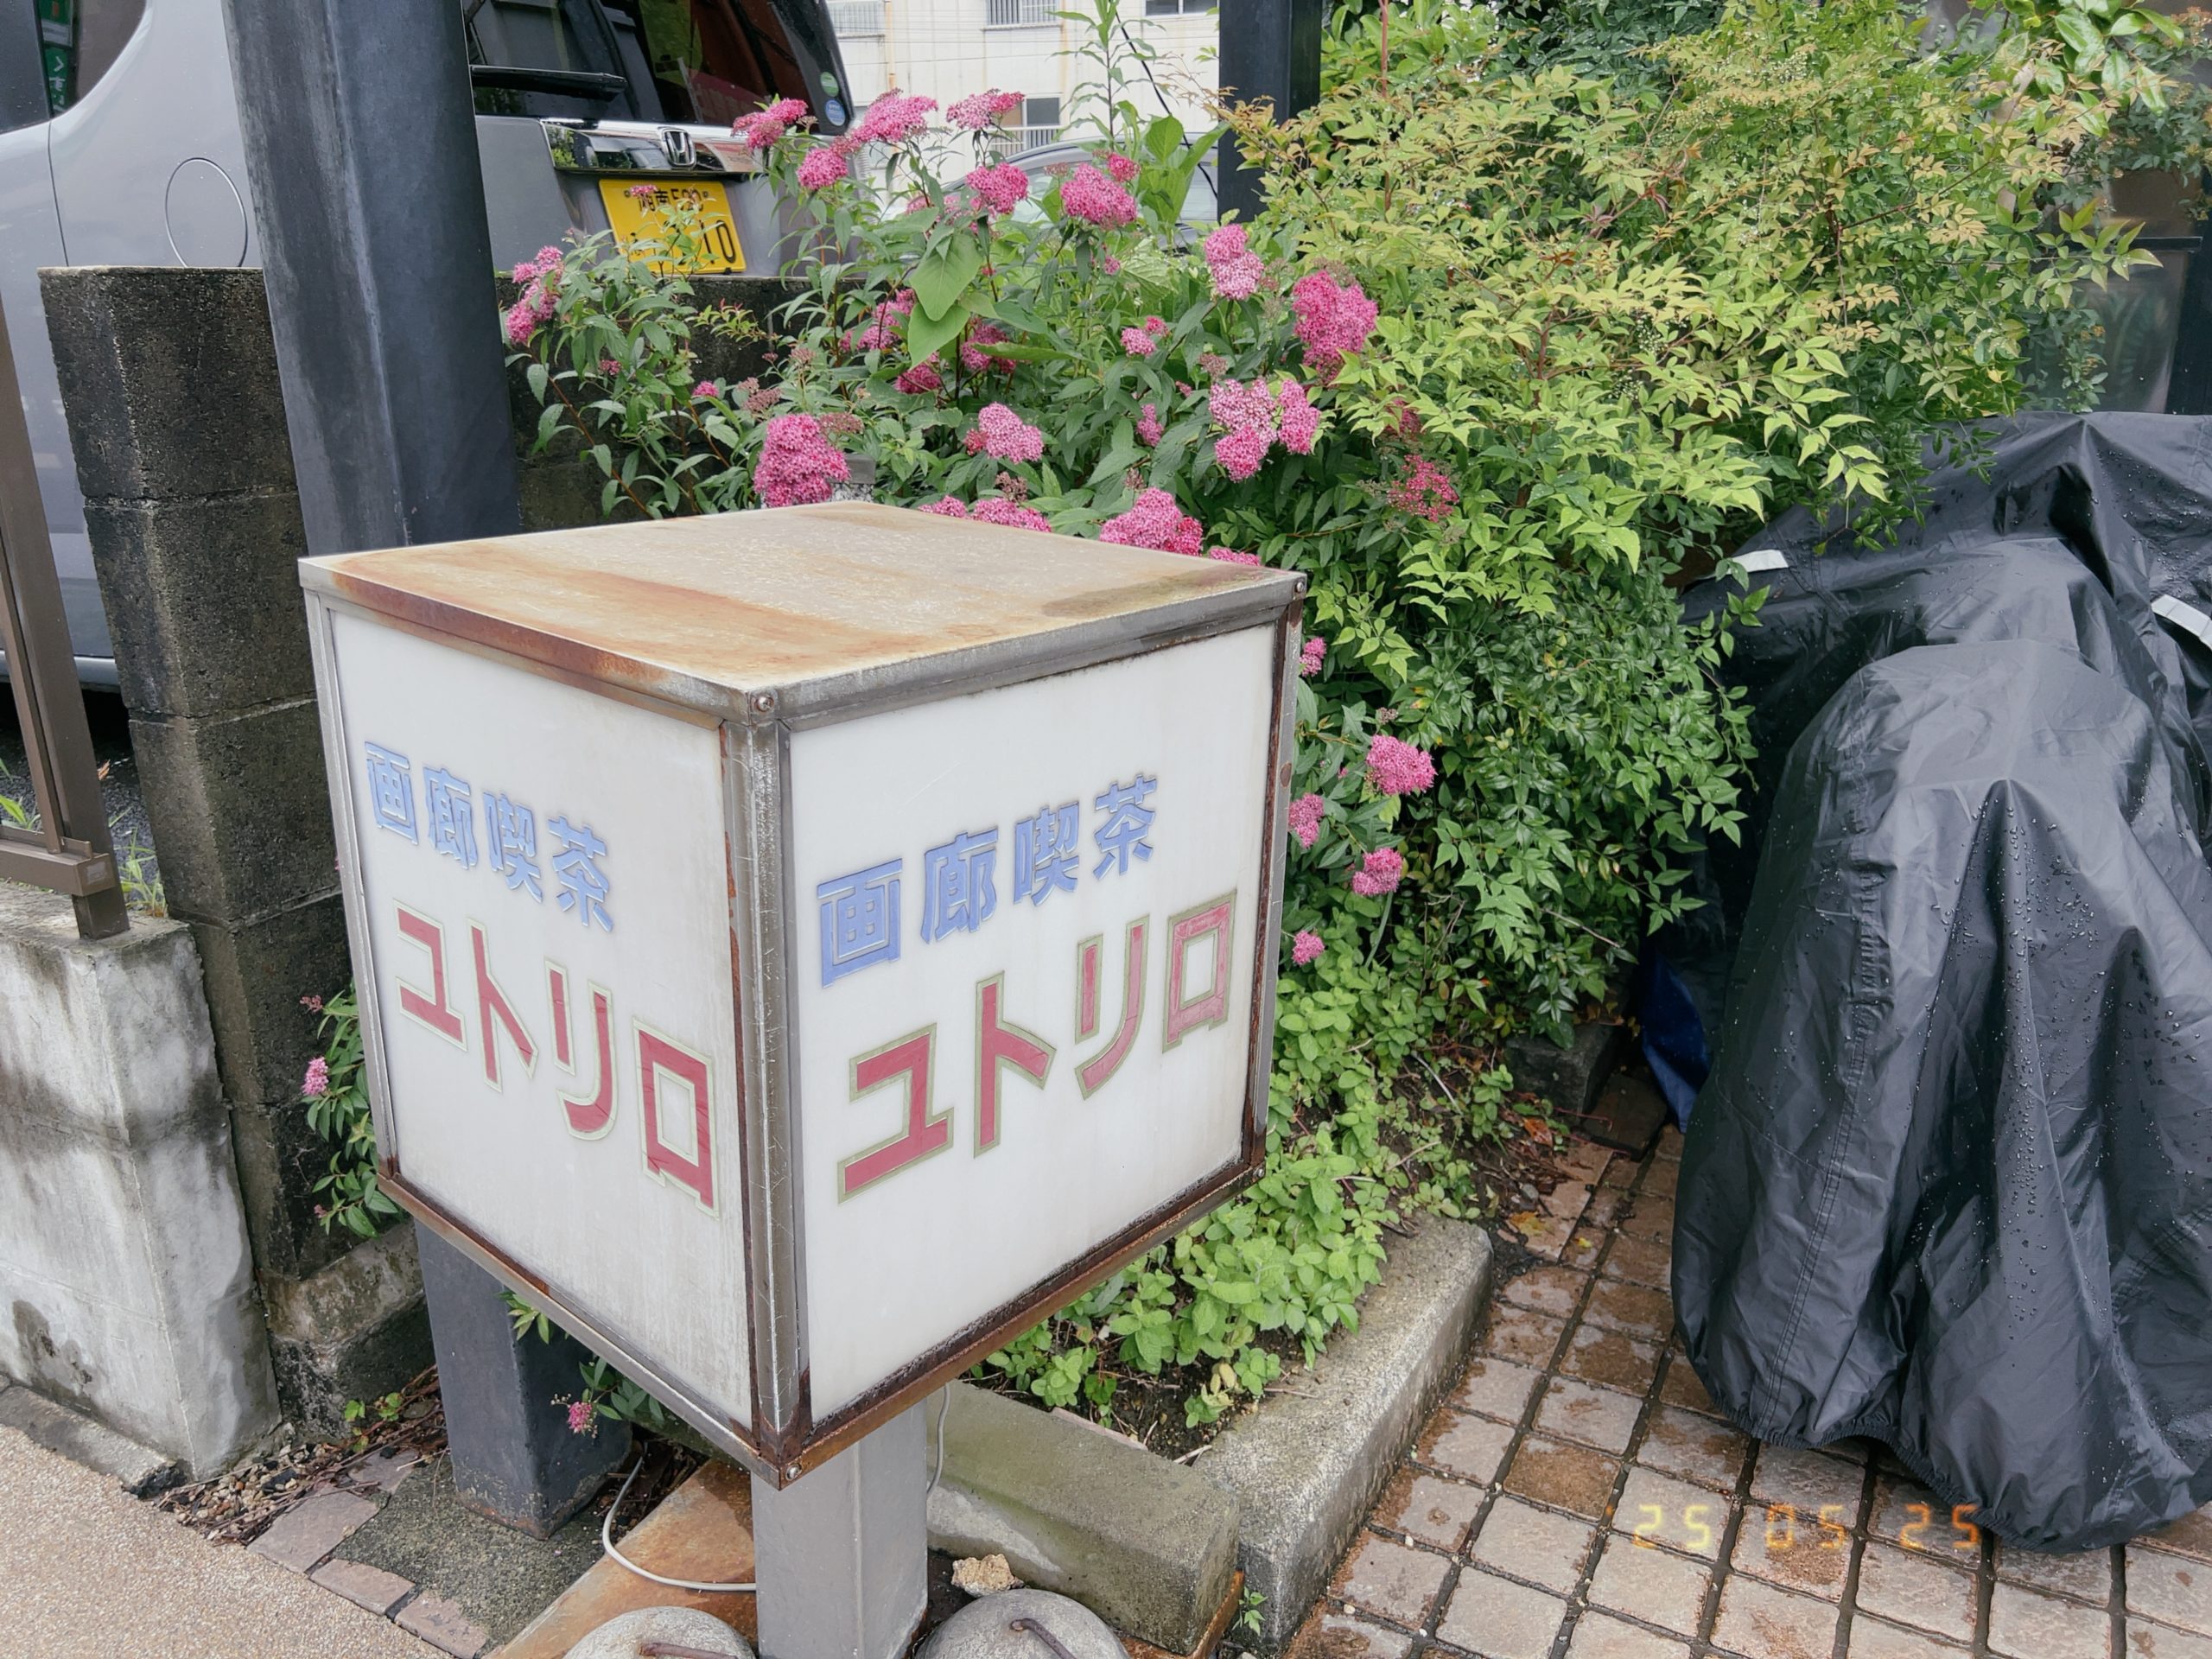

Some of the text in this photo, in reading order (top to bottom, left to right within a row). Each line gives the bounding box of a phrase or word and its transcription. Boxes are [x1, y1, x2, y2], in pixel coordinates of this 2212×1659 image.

[365, 741, 615, 932] 画廊喫茶
[817, 773, 1158, 988] 画廊喫茶
[393, 898, 720, 1220] ユトリロ
[838, 889, 1237, 1205] ユトリロ
